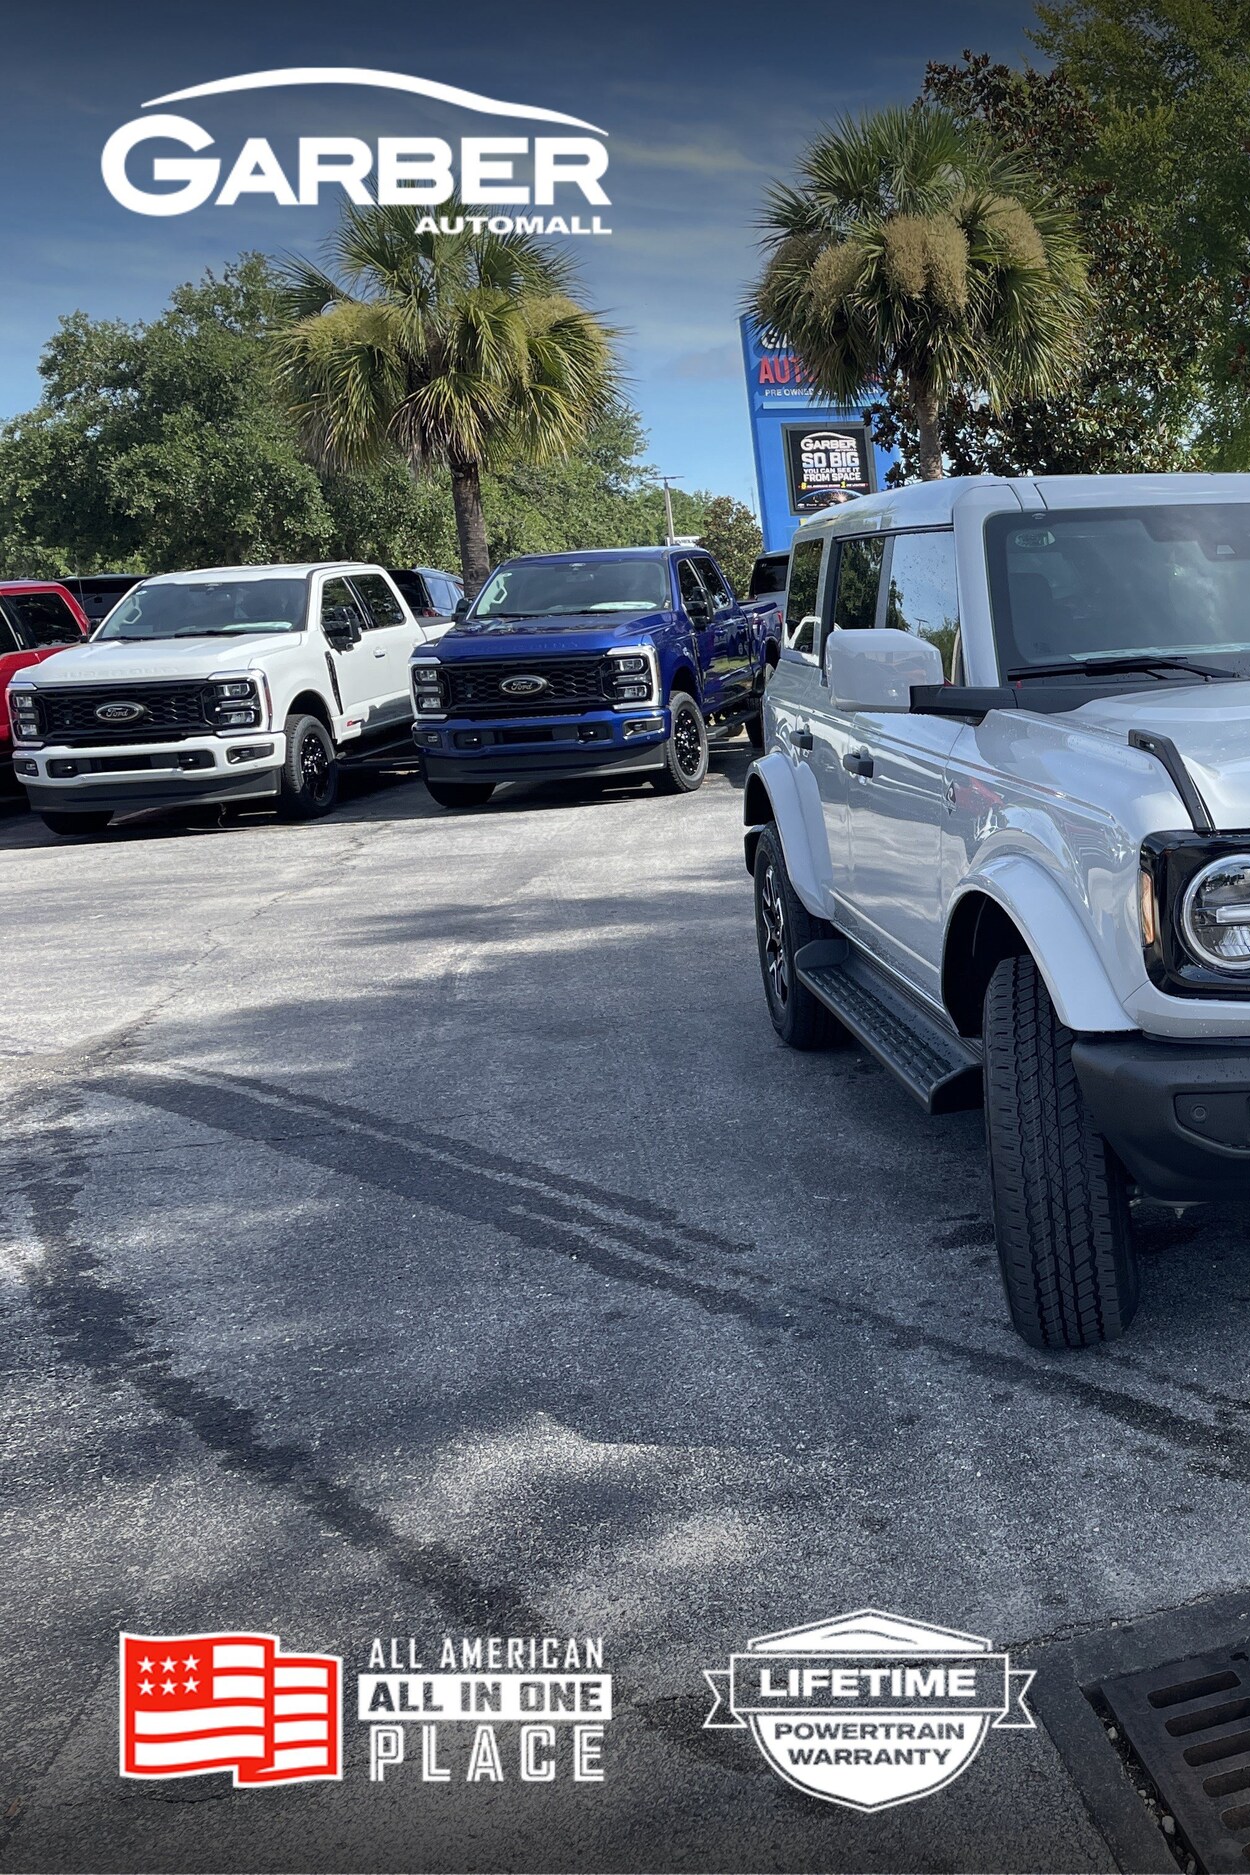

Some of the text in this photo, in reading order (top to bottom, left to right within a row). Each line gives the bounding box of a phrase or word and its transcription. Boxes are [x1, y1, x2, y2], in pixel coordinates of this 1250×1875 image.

[801, 438, 857, 451] GARBER
[801, 451, 860, 468] SO BIG
[803, 472, 861, 482] FROM SPACE
